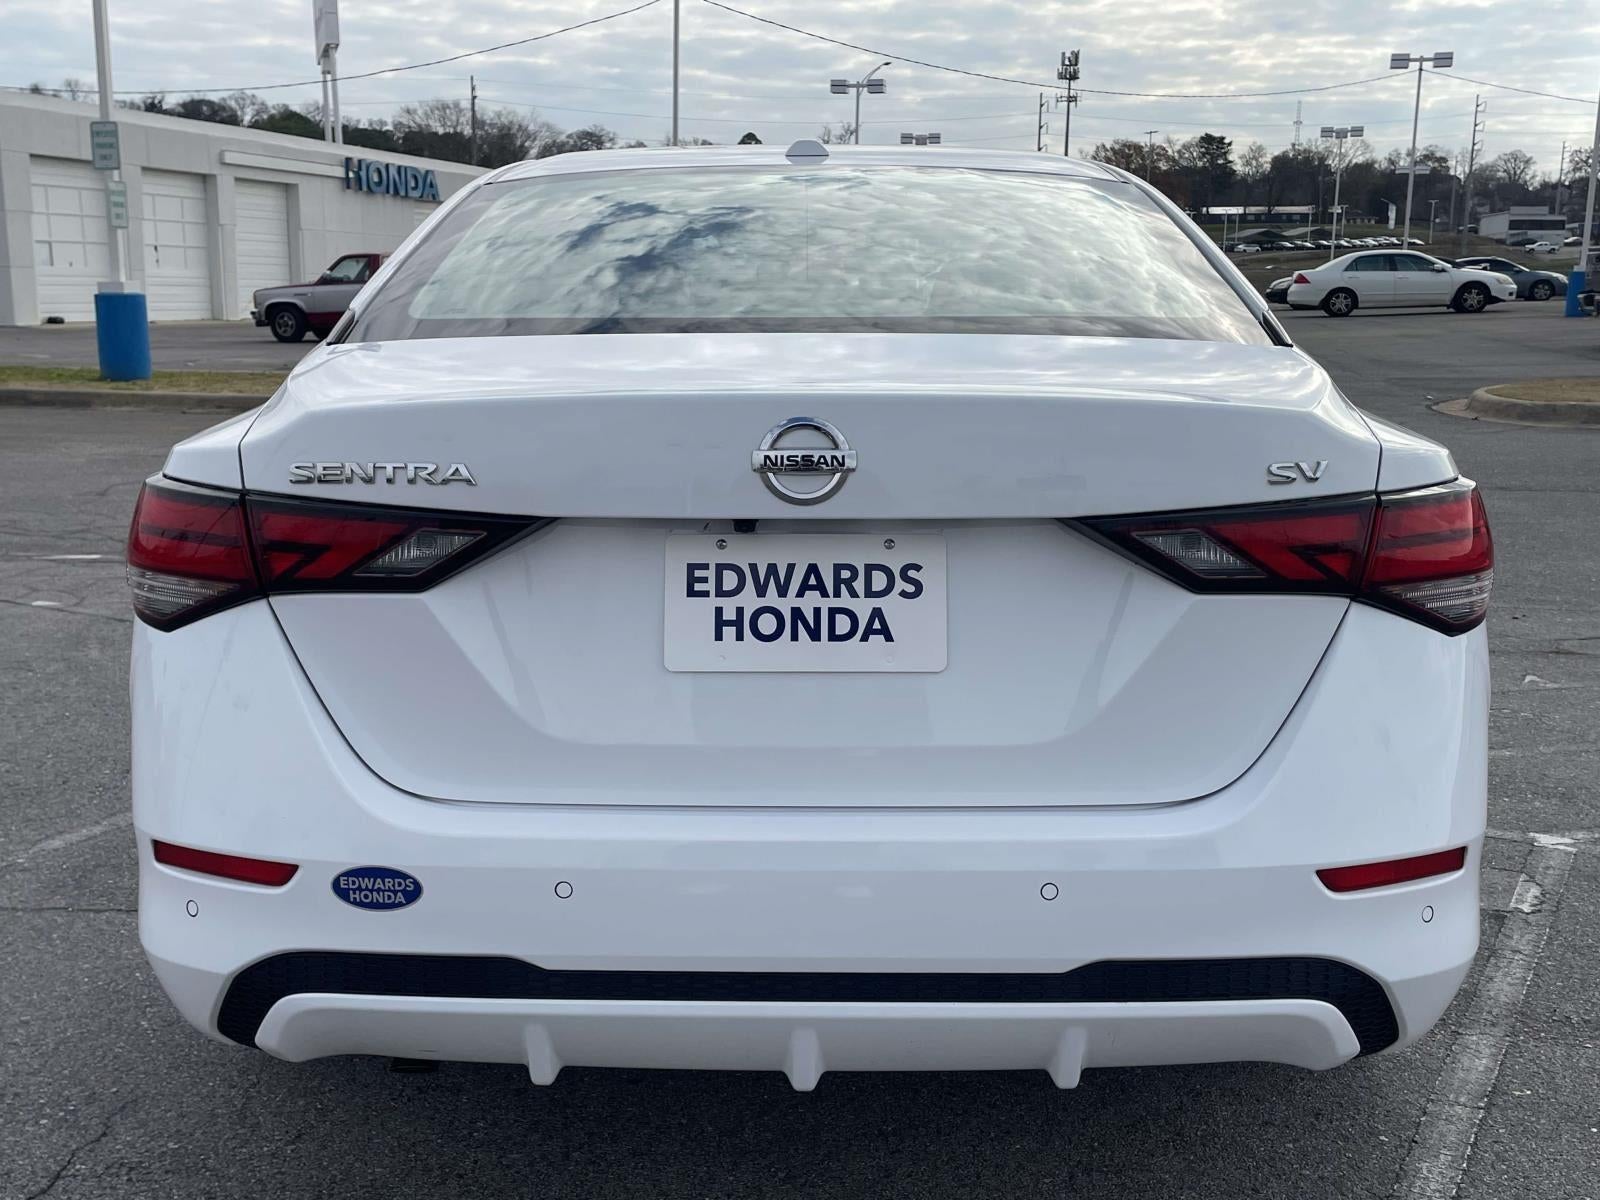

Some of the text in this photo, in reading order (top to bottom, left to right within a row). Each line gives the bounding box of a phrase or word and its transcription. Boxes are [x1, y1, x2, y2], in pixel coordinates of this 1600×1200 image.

[343, 157, 440, 201] HONDA
[763, 454, 846, 468] NISSAN
[1267, 460, 1328, 485] SV
[289, 462, 477, 486] SENTRA
[686, 562, 924, 600] EDWARDS
[714, 605, 895, 643] HONDA
[339, 876, 415, 891] EDWARDS
[349, 890, 406, 904] HONDA
